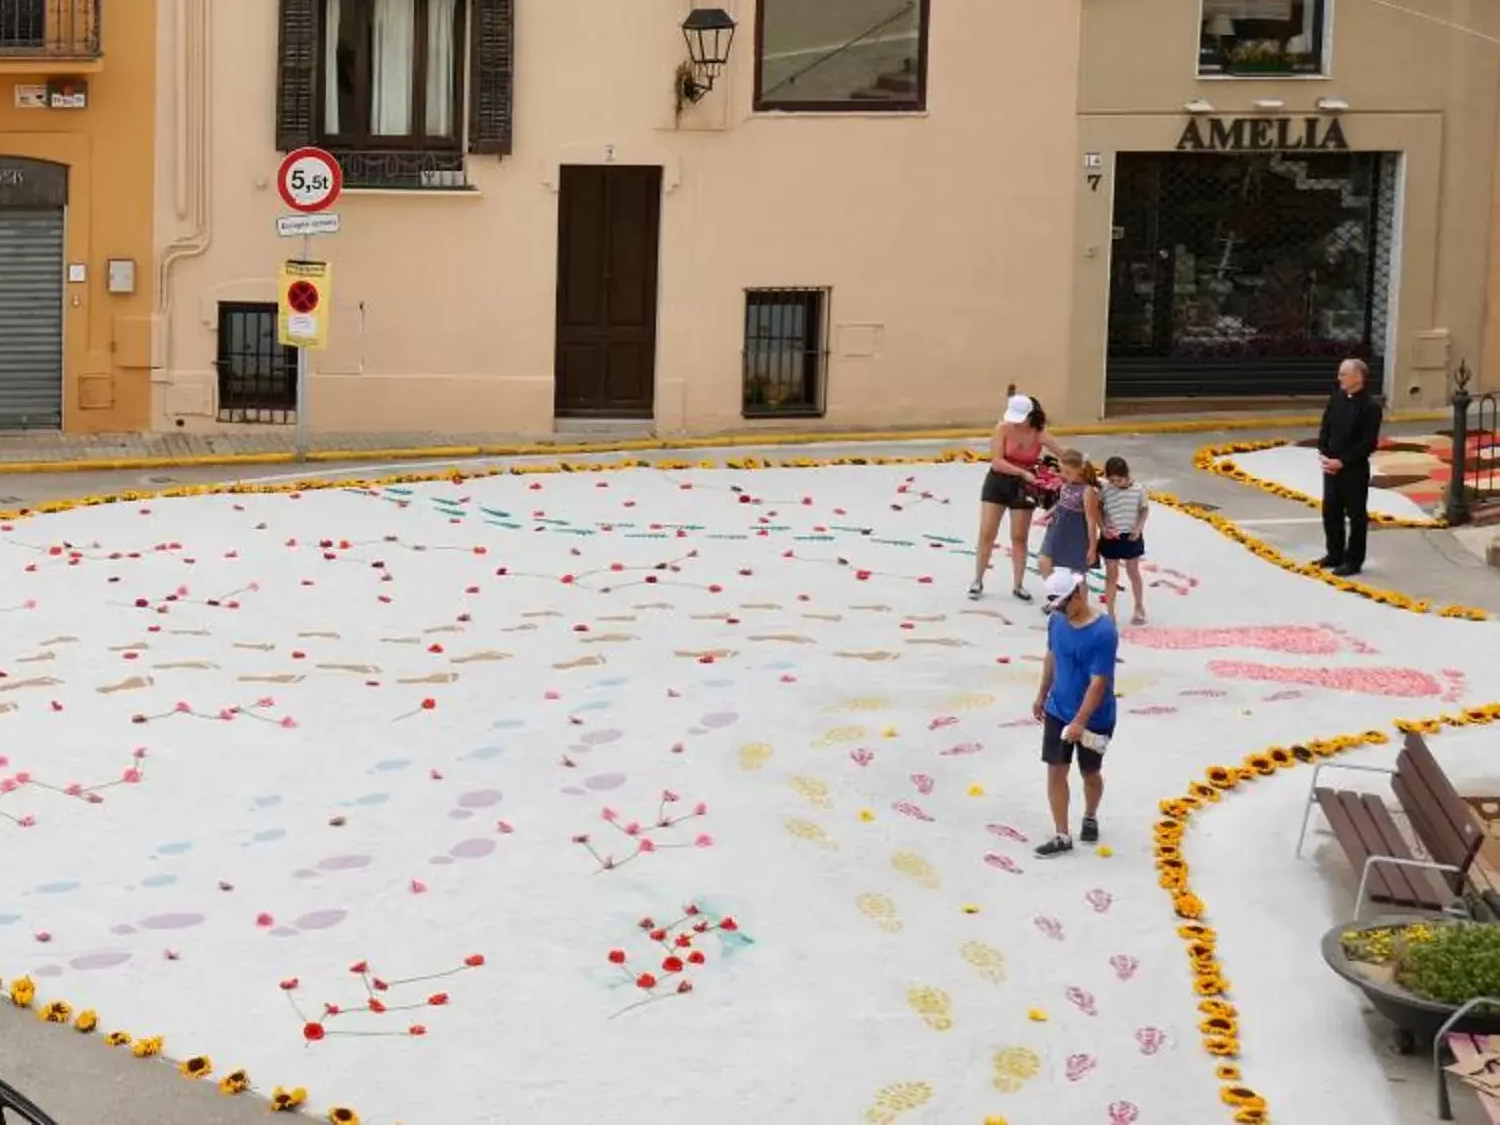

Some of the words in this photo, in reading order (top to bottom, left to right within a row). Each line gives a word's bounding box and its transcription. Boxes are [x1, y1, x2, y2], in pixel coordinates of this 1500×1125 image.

[1176, 117, 1348, 150] AMELIA
[291, 170, 329, 193] 5,5t
[1087, 174, 1103, 192] 7
